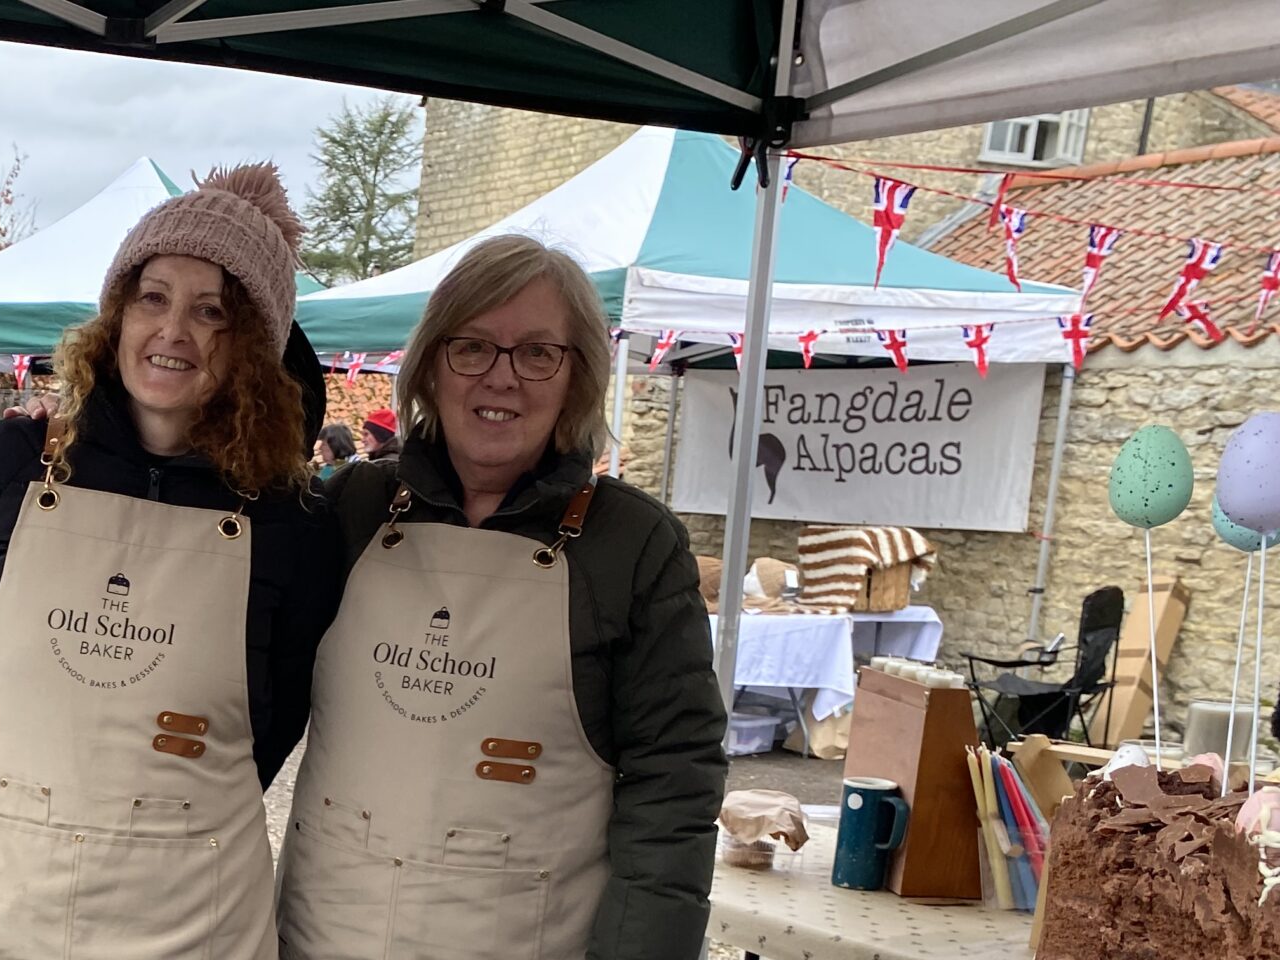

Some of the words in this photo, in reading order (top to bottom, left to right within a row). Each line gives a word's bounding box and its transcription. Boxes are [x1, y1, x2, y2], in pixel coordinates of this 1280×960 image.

[763, 379, 973, 433] Fangdale
[792, 433, 962, 482] Alpacas
[101, 597, 130, 613] THE
[47, 608, 89, 634] Old
[94, 614, 175, 645] School
[424, 633, 450, 647] THE
[79, 641, 134, 661] BAKER
[373, 642, 413, 668] Old
[416, 649, 496, 679] School
[58, 657, 86, 685] SCHOOL
[89, 679, 117, 689] BAKES
[129, 651, 166, 685] DESSERTS
[401, 675, 454, 696] BAKER
[381, 690, 407, 718] SCHOOL
[410, 713, 438, 724] BAKES
[450, 686, 487, 719] DESSERTS
